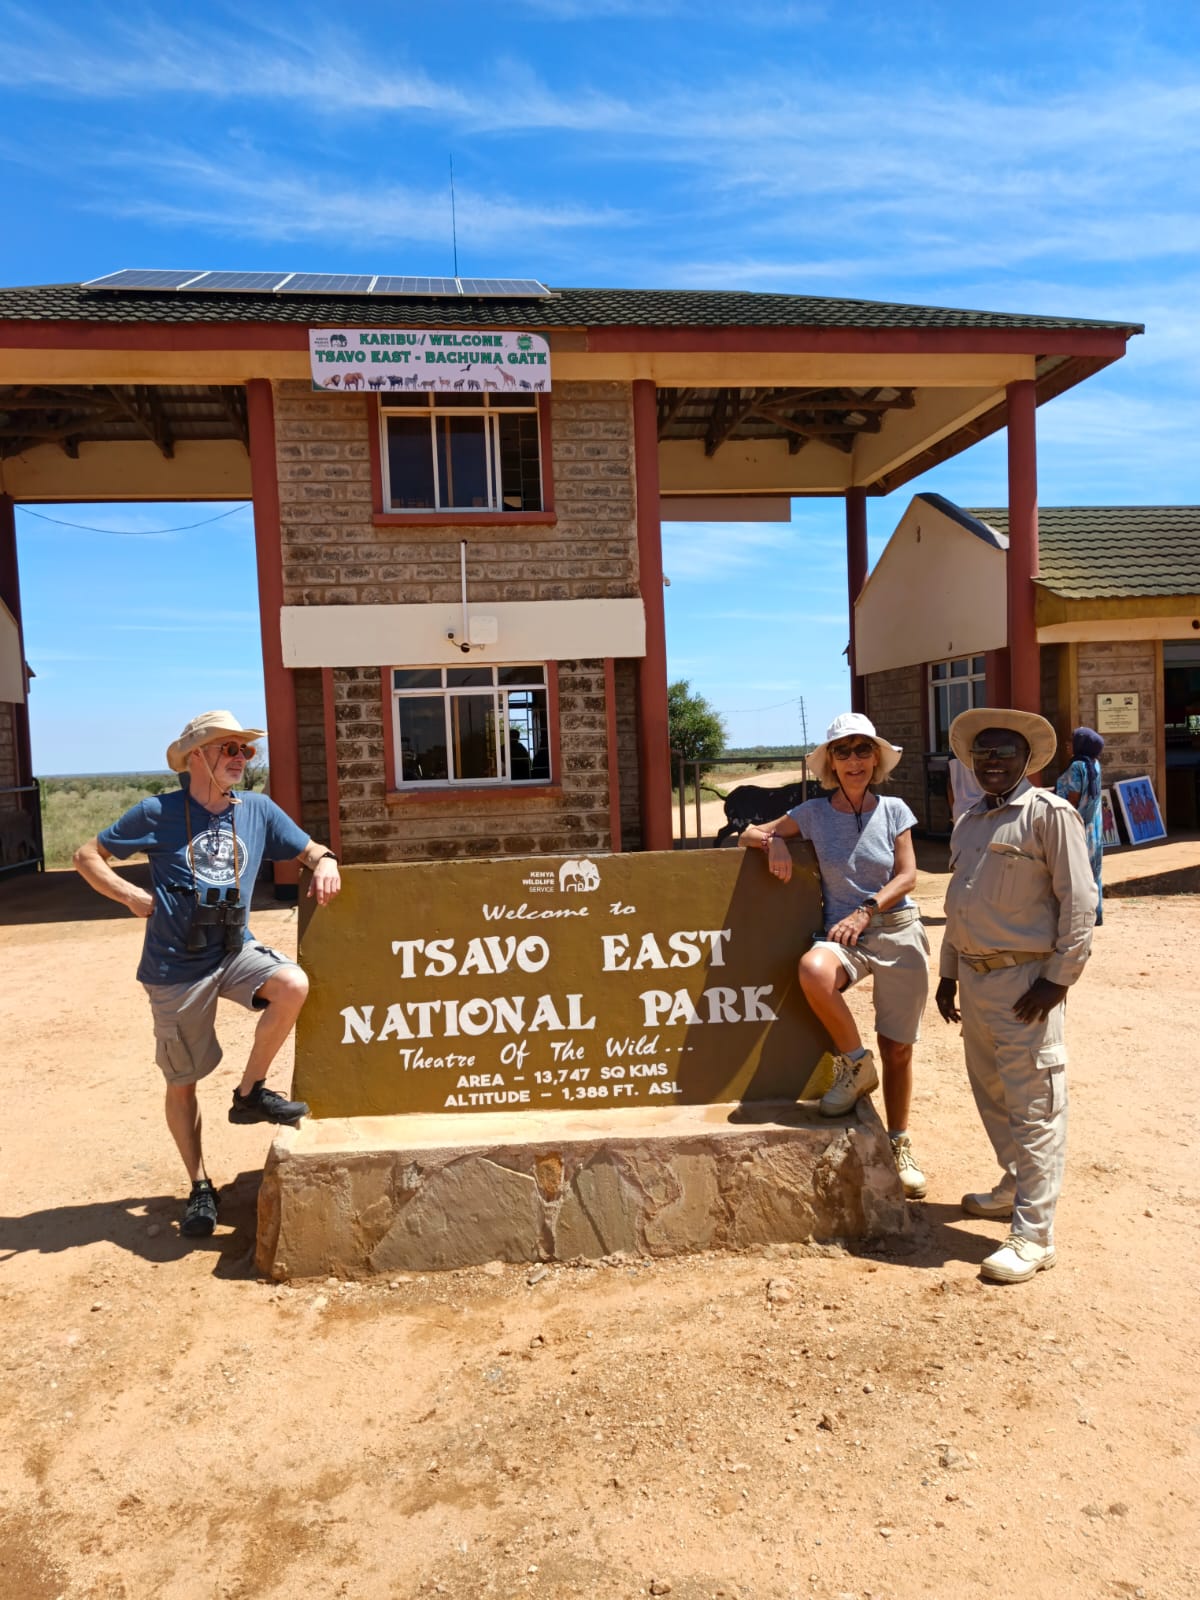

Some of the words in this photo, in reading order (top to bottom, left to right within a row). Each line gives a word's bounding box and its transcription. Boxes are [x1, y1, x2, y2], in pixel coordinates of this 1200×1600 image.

[429, 334, 503, 347] WELCOME
[315, 350, 366, 363] TSAVO
[371, 350, 411, 363] EAST
[425, 351, 503, 364] BACHUMA
[507, 352, 547, 365] GATE
[482, 903, 590, 920] Welcome
[609, 901, 637, 915] to
[391, 935, 550, 979] TSAVO
[601, 928, 732, 972] EAST
[339, 993, 597, 1045] NATIONAL
[638, 985, 779, 1027] PARK
[399, 1048, 476, 1071] Theatre
[500, 1039, 530, 1070] Of
[550, 1039, 585, 1062] The
[456, 1073, 505, 1089] AREA
[533, 1067, 591, 1086] 13,747
[600, 1065, 626, 1080] SQ
[629, 1062, 668, 1078] KMS
[444, 1090, 531, 1107] ALTITUDE
[561, 1085, 609, 1101] 1,388
[613, 1084, 639, 1097] FT.
[648, 1081, 683, 1096] ASL
